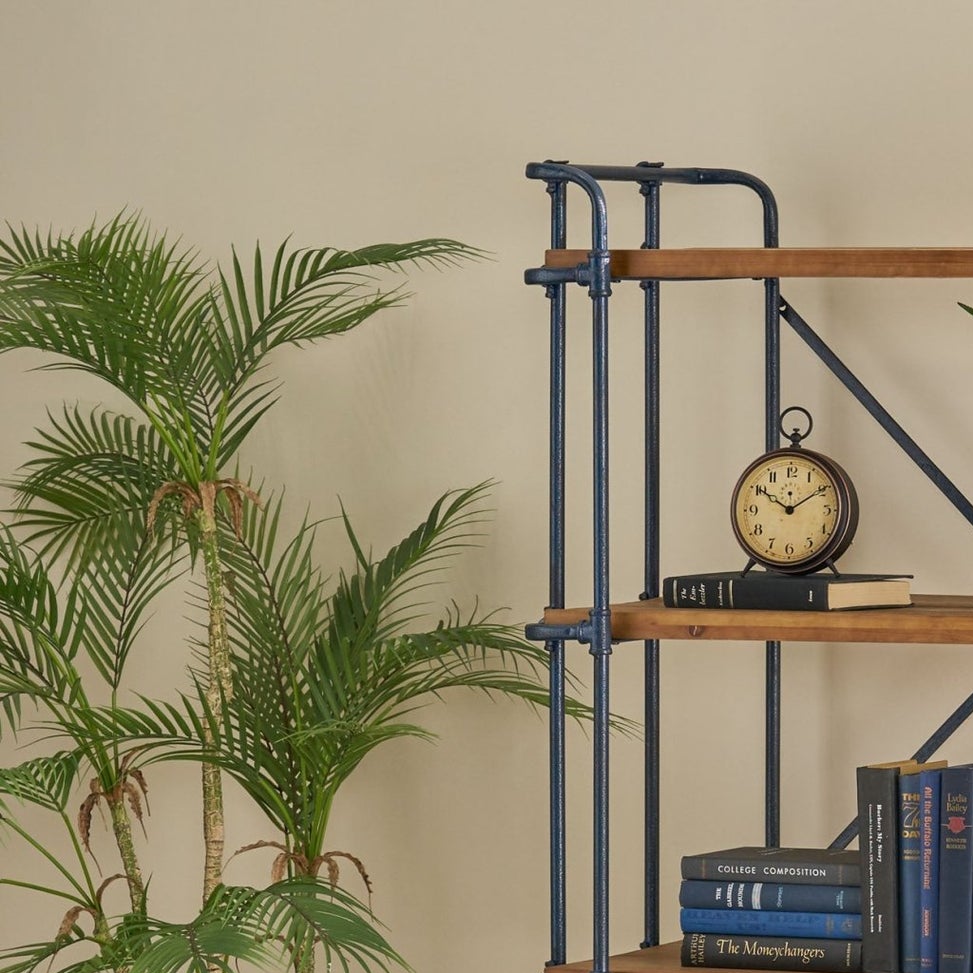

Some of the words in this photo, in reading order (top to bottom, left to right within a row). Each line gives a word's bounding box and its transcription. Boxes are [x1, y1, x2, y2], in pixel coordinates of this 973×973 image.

[769, 471, 777, 483] 11
[786, 466, 798, 478] 12
[806, 471, 811, 483] 1
[755, 484, 767, 496] 10
[818, 484, 827, 497] 2
[749, 505, 758, 517] 9
[753, 524, 763, 536] 8
[768, 537, 775, 549] 7
[785, 543, 794, 555] 6
[804, 537, 813, 549] 5
[902, 793, 920, 801] TH
[924, 787, 932, 798] All
[947, 793, 967, 803] Lydia
[924, 801, 932, 814] the
[947, 803, 967, 814] Bailey
[877, 832, 882, 843] My
[924, 817, 932, 846] Buffalo
[717, 864, 757, 875] COLLEGE
[764, 867, 827, 877] COMPOSITION
[698, 934, 706, 962] HAILEY
[717, 939, 739, 954] The
[743, 941, 825, 963] Moneychangers
